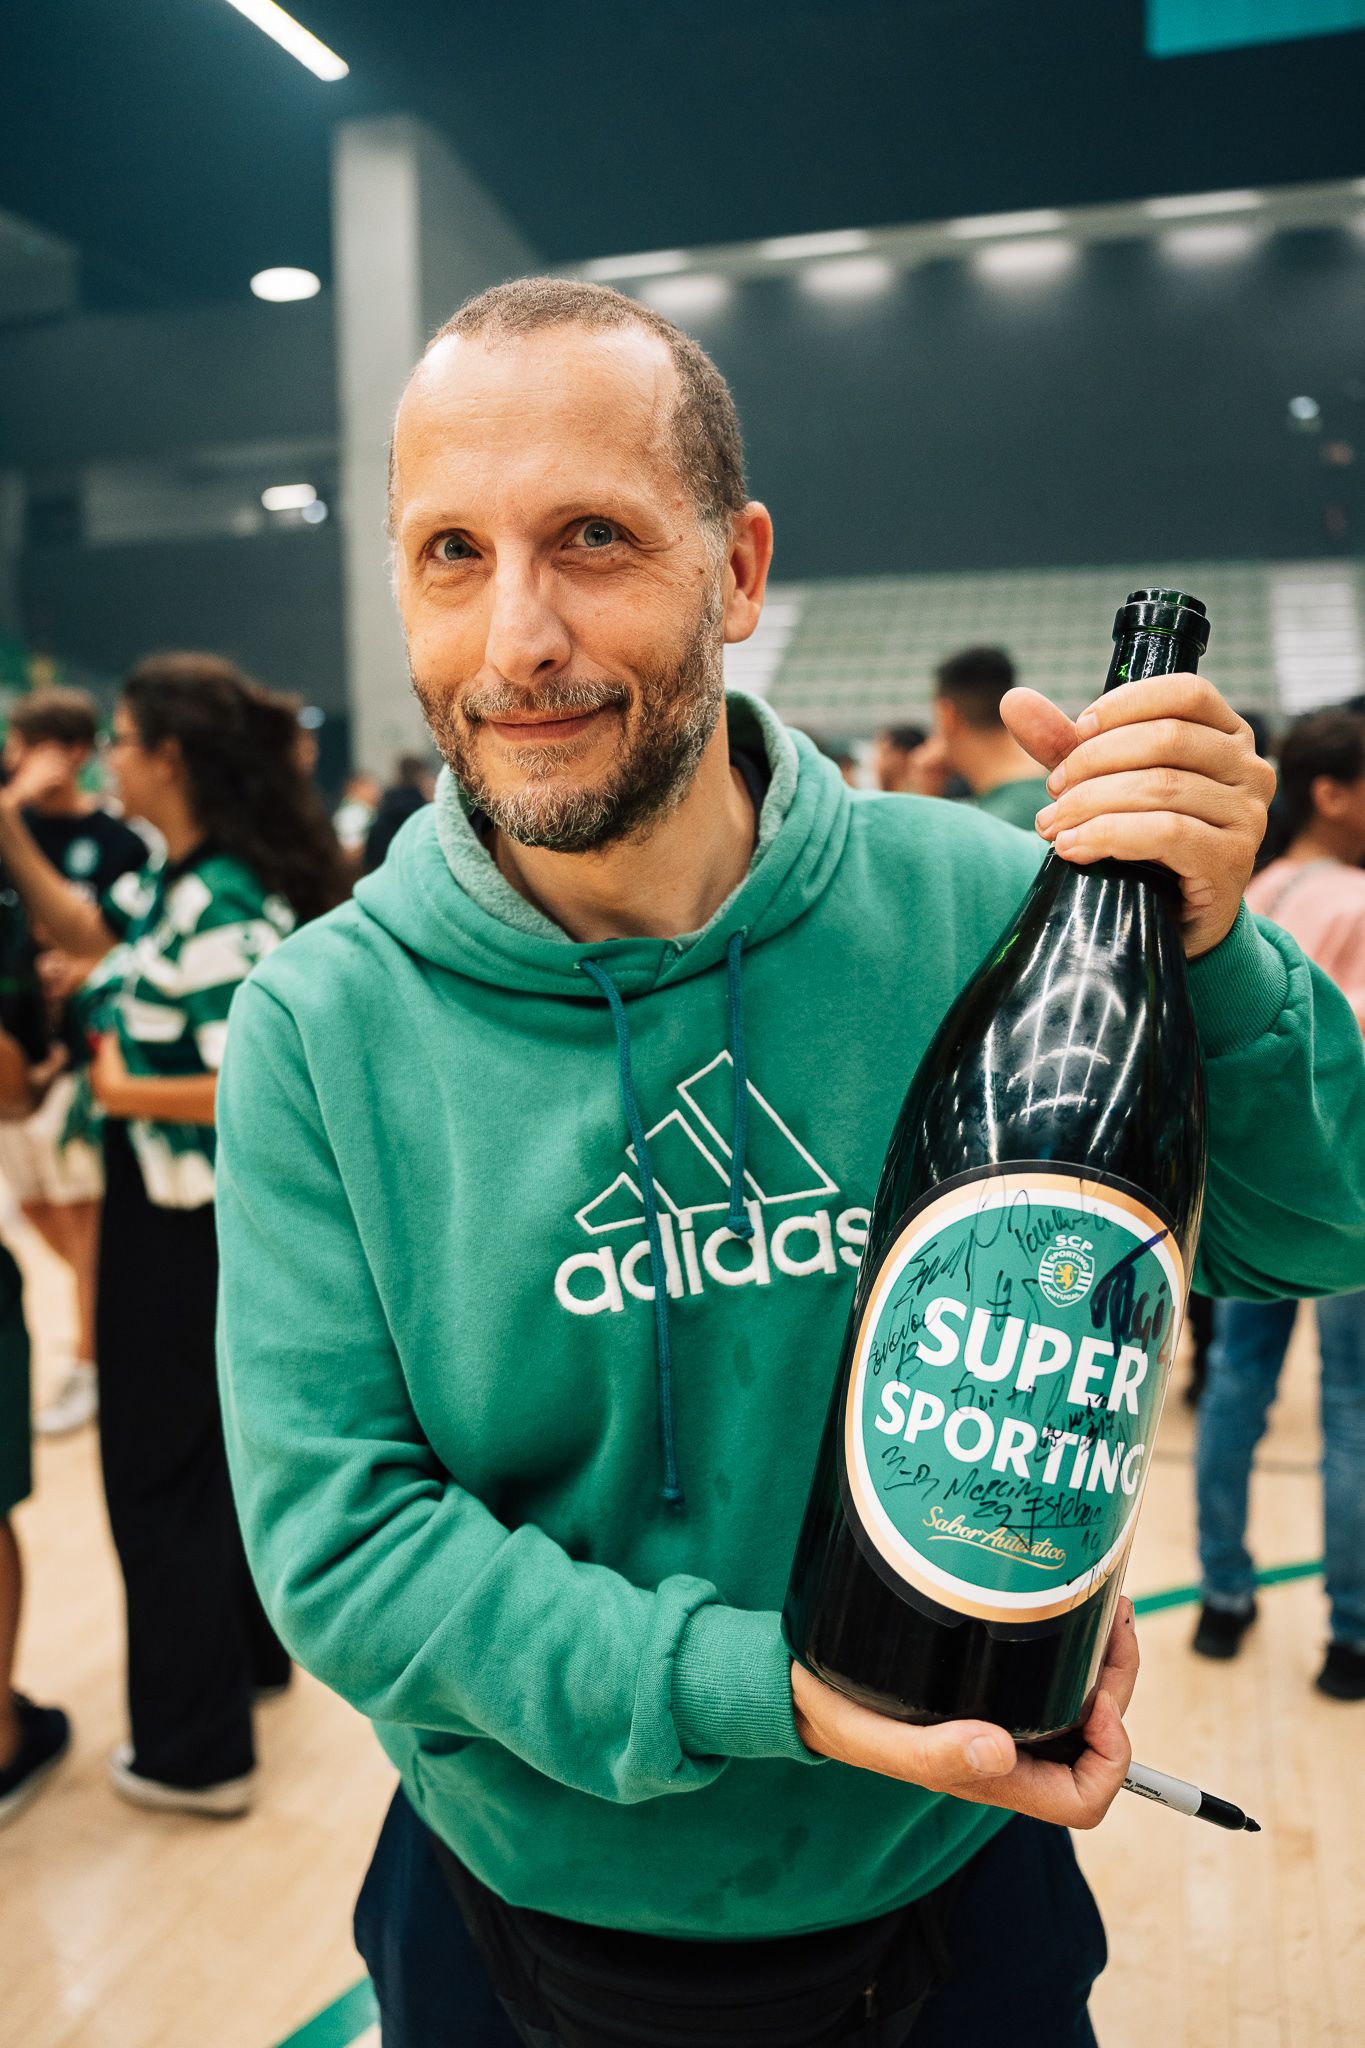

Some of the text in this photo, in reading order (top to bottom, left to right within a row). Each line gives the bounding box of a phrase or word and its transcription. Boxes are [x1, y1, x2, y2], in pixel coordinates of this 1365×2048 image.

[554, 1200, 872, 1315] adidas
[1056, 1234, 1093, 1250] SCP
[1048, 1250, 1089, 1271] SPORTING
[1044, 1284, 1081, 1301] PORTUGAL
[916, 1297, 1148, 1415] SUPER
[874, 1380, 1145, 1496] SPORTING
[922, 1506, 983, 1540] Sabor
